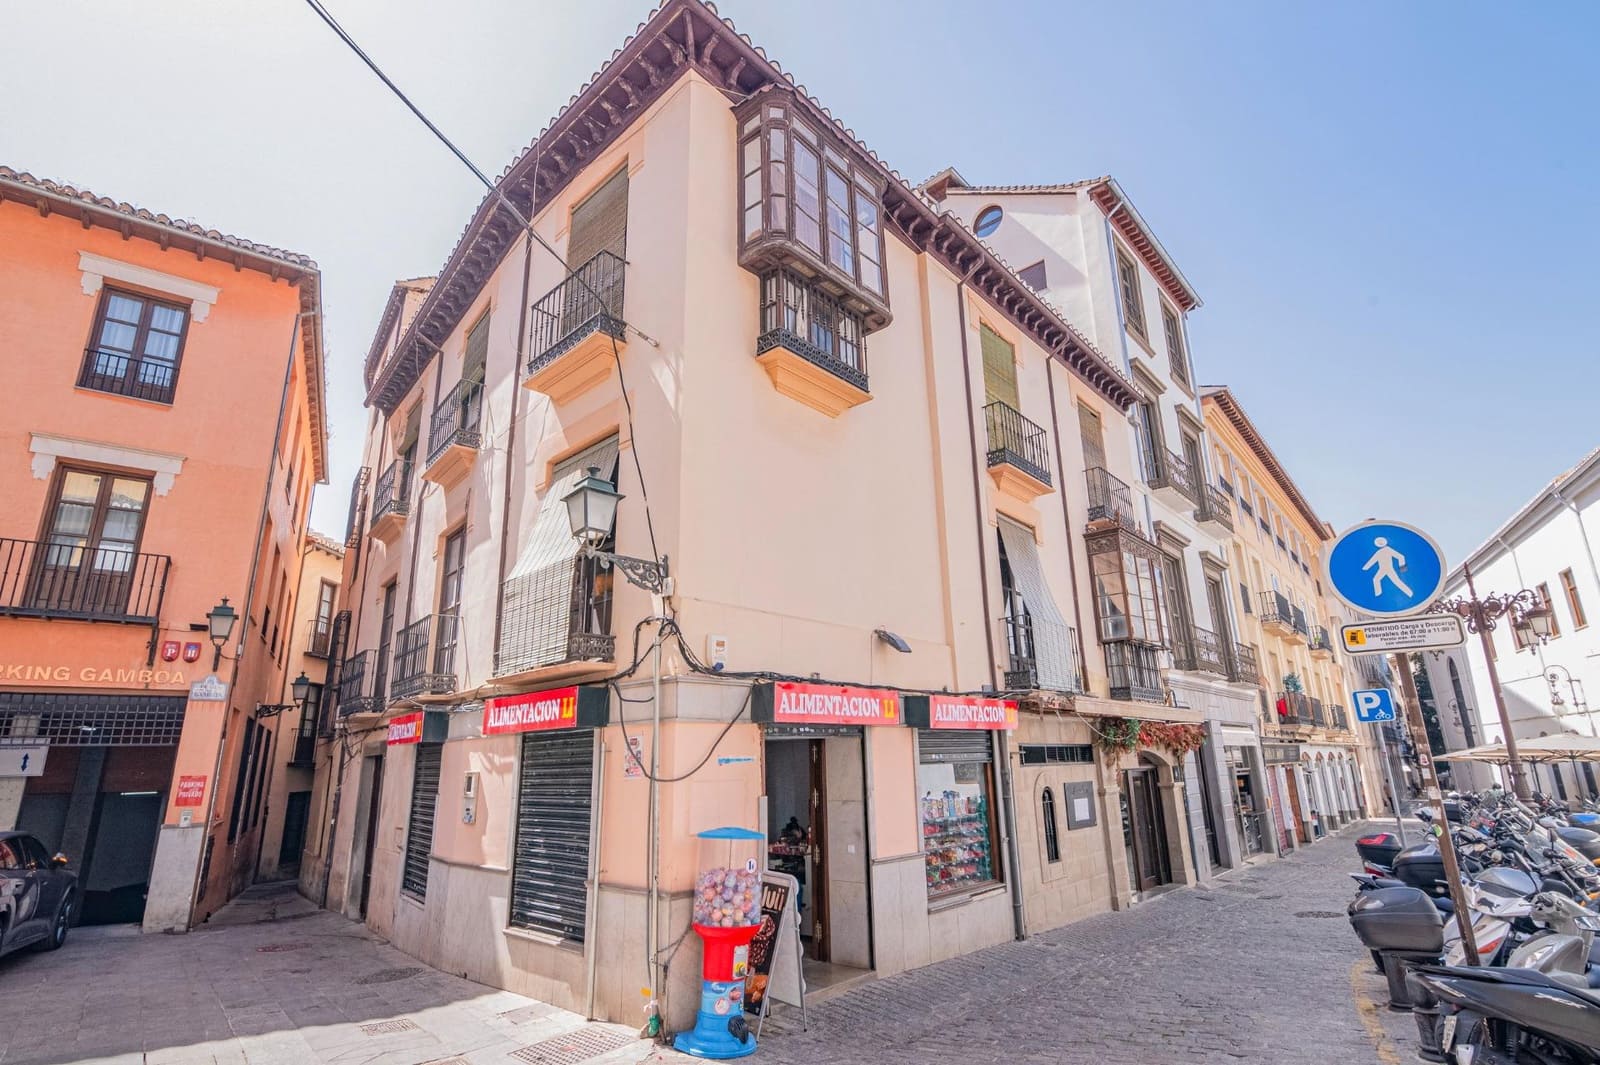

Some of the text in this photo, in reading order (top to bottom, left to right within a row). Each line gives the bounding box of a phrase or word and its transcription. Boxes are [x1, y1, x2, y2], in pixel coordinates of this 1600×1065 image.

[1364, 625, 1399, 633] PERMITIDO
[1425, 620, 1456, 628] Descarga
[1365, 630, 1399, 638] laborables
[0, 665, 185, 684] KING GAMBOA
[487, 699, 560, 727] ALIMENTACION
[779, 692, 880, 717] ALIMENTACION
[935, 703, 1005, 722] ALIMENTACION
[1356, 692, 1380, 717] P
